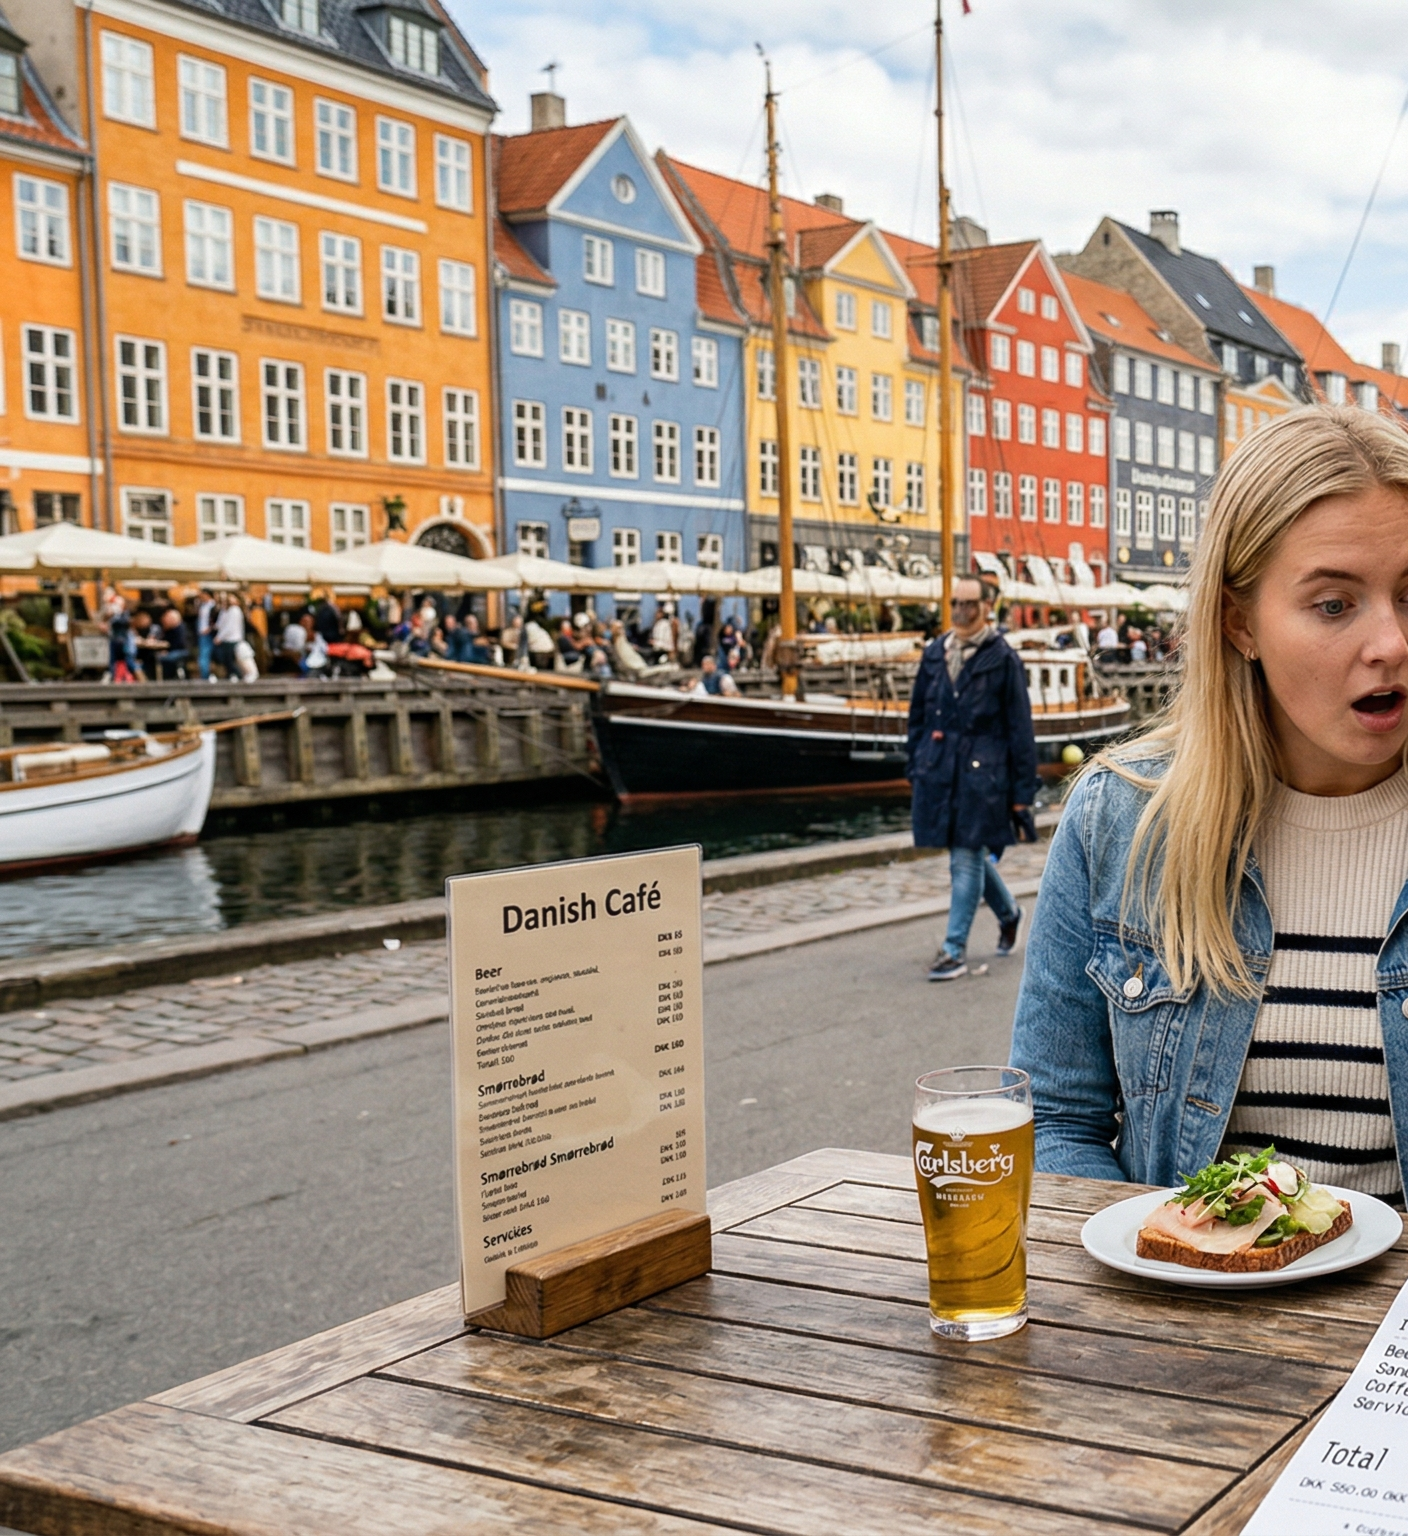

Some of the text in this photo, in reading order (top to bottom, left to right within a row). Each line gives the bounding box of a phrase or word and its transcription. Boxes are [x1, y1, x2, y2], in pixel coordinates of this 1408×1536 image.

[503, 880, 662, 934] Danish Café
[475, 967, 503, 980] Beer
[915, 1140, 1015, 1177] Carlsberg
[1321, 1441, 1389, 1471] Total
